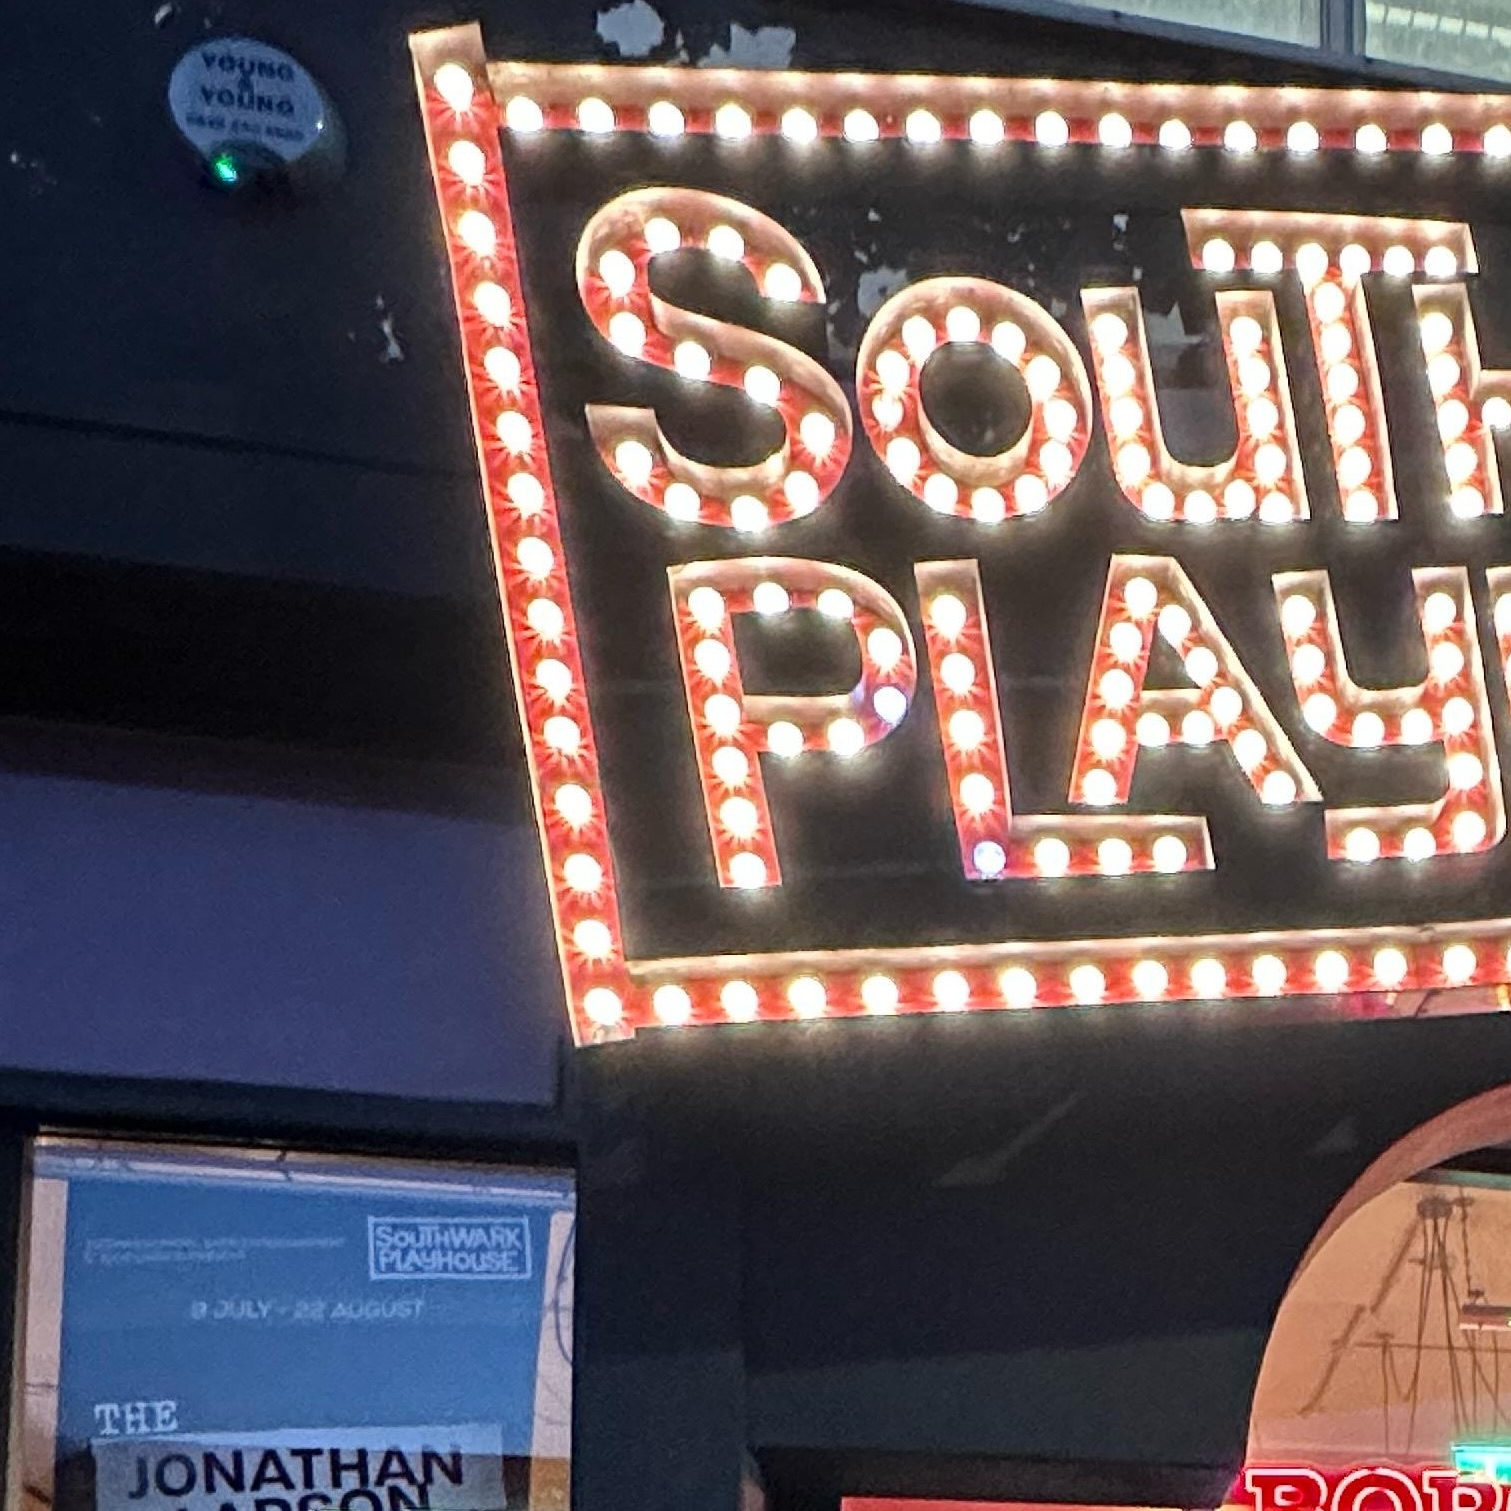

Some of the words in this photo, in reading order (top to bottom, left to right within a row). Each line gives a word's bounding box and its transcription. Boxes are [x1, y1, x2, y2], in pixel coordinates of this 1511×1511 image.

[376, 1225, 522, 1250] SOUTHWARK
[379, 1248, 519, 1272] PLAYHOUSE
[213, 1298, 272, 1320] JULY
[330, 1297, 425, 1319] AUGUST
[94, 1400, 179, 1435] THE
[129, 1444, 464, 1500] JONATHAN
